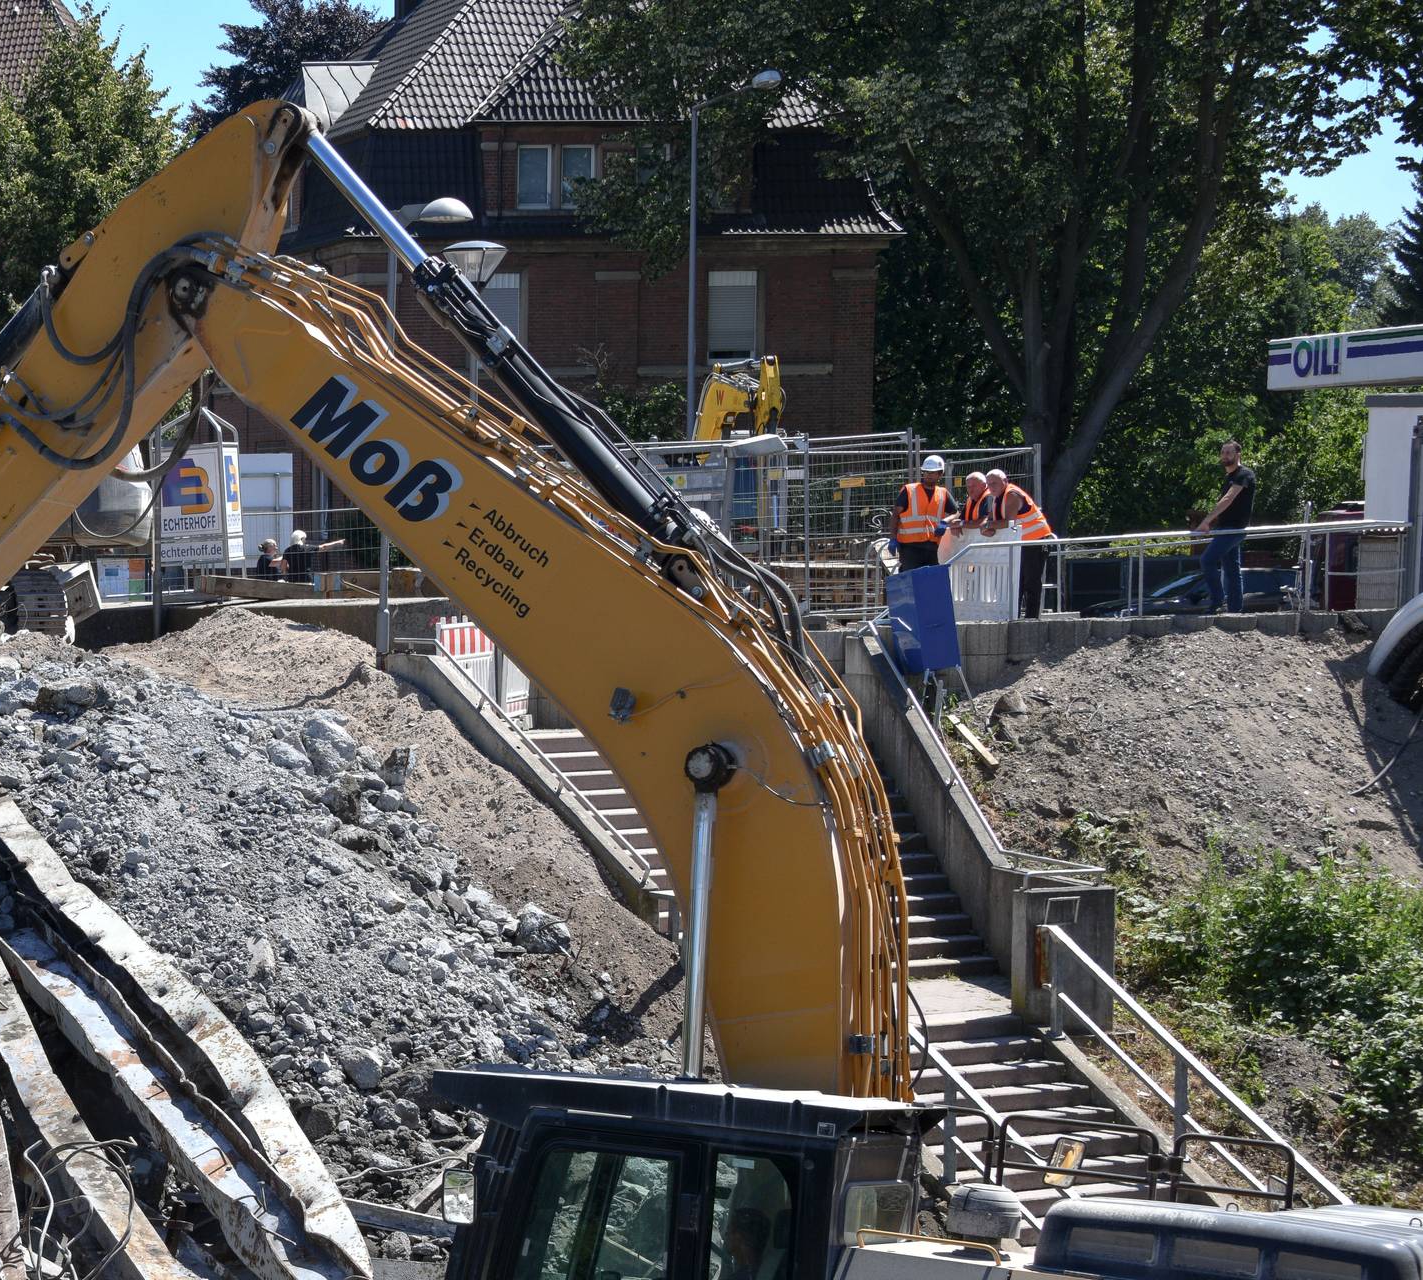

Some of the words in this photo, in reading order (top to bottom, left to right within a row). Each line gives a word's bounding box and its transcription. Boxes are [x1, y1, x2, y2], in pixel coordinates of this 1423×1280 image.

[1293, 337, 1342, 378] OIL!
[290, 375, 464, 522] Moß
[163, 515, 216, 532] ECHTERHOFF
[483, 509, 550, 568] Abbruch
[468, 527, 525, 580] Erdbau
[455, 548, 531, 619] Recycling
